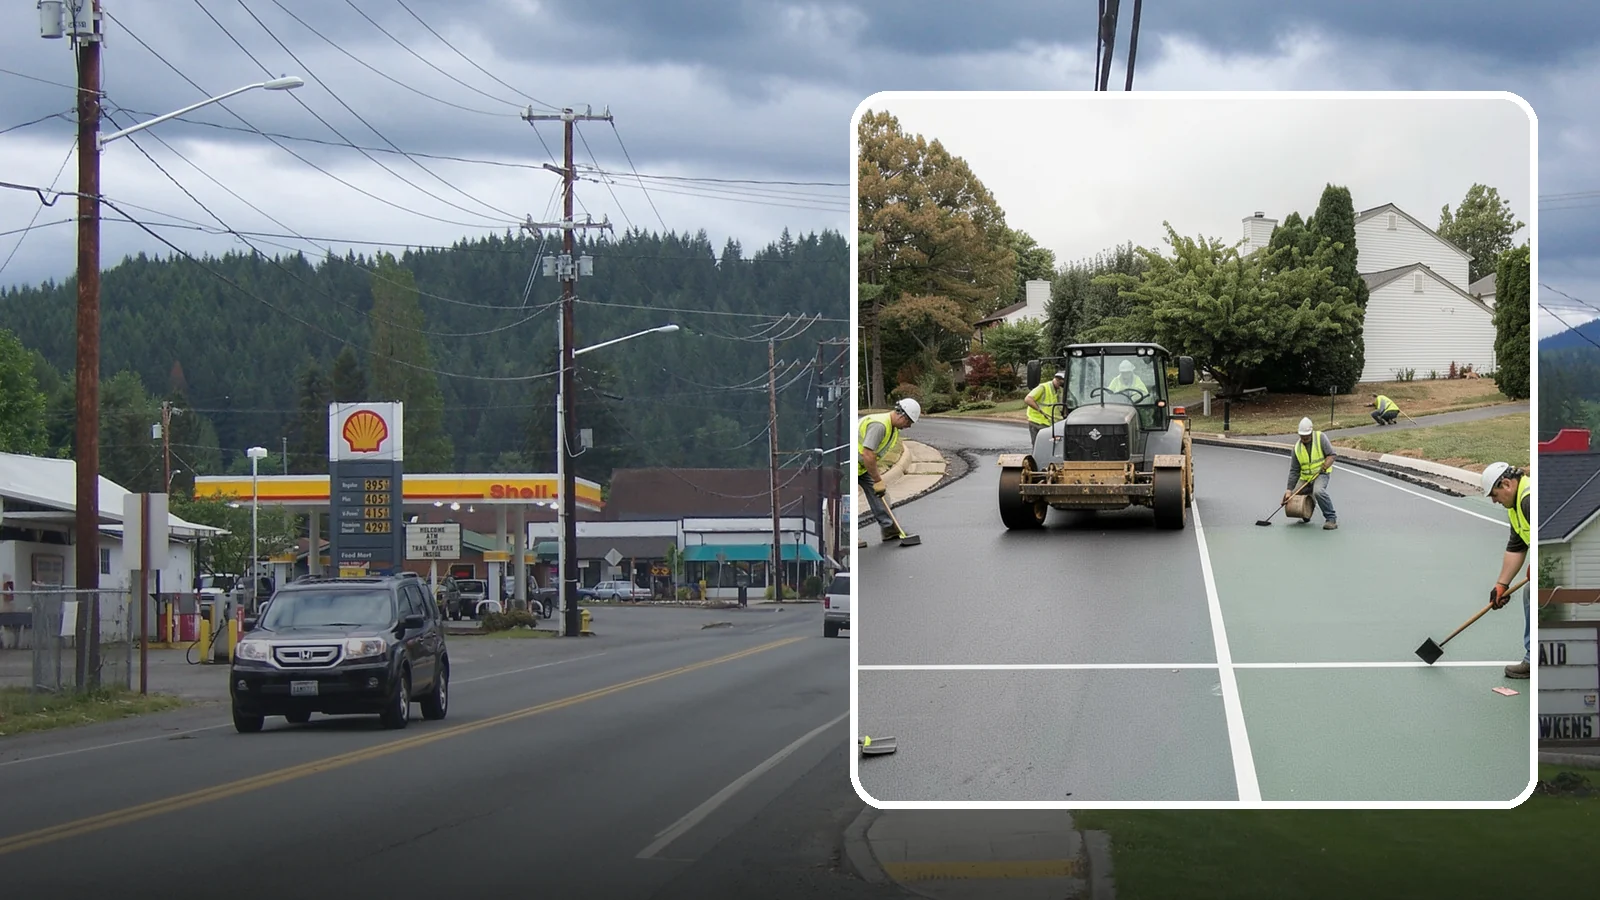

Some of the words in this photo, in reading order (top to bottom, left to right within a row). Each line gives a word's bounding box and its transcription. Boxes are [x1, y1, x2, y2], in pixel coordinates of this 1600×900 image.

[365, 480, 383, 490] 395
[490, 484, 547, 499] Shell
[365, 494, 383, 504] 405
[366, 508, 383, 518] 415
[366, 522, 383, 532] 429
[1539, 643, 1567, 665] AID
